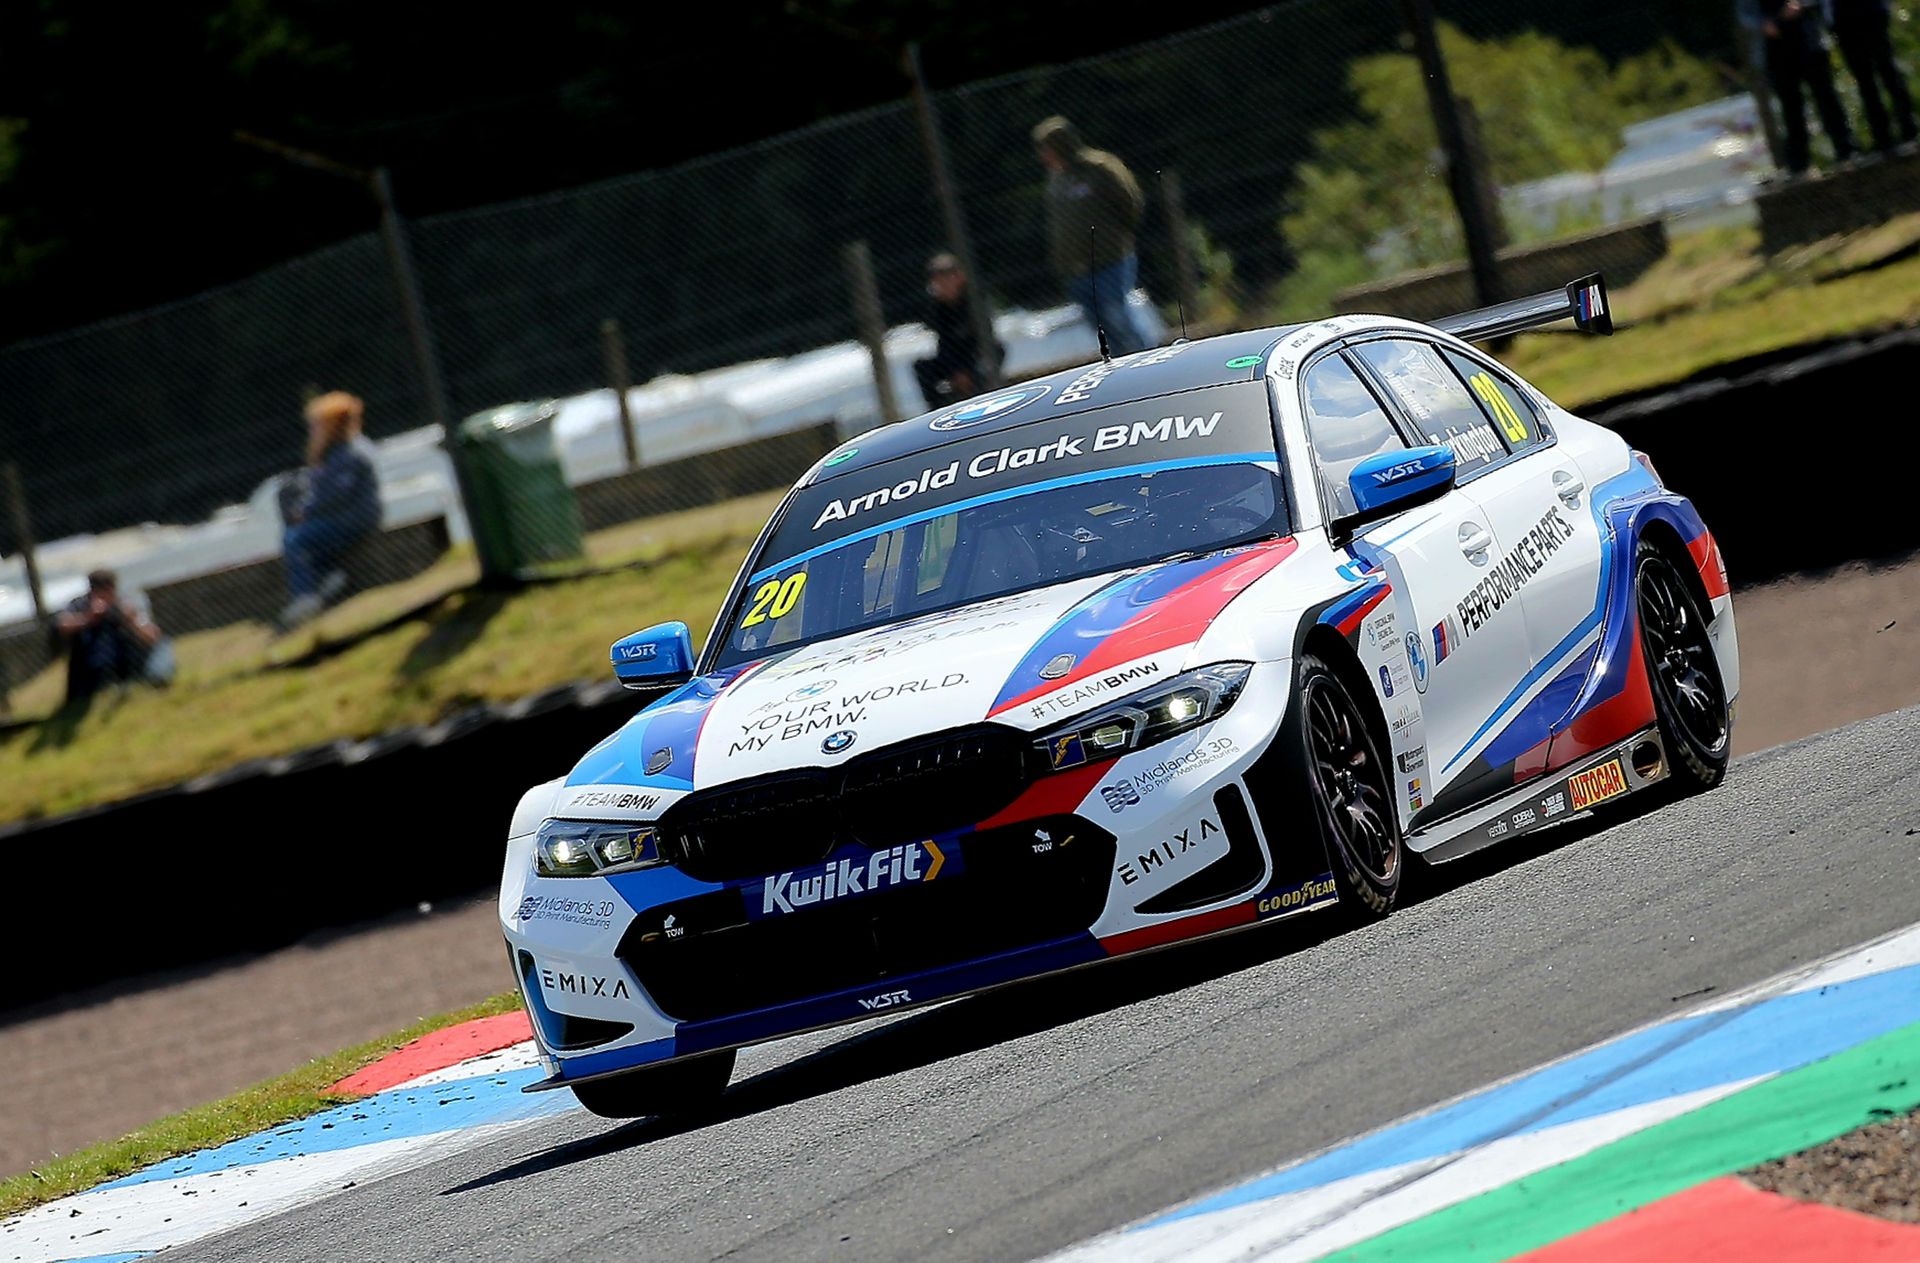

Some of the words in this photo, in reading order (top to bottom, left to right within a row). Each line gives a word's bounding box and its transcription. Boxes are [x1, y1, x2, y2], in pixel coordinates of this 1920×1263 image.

[1470, 371, 1528, 444] 20
[812, 460, 961, 531] Arnold
[968, 434, 1084, 480] Clark
[1093, 411, 1224, 452] BMW
[1371, 460, 1425, 483] WSR
[1456, 536, 1544, 638] PERFORMANCE
[1529, 505, 1575, 562] PARTS.
[740, 571, 808, 630] 20
[620, 643, 657, 659] WSR
[741, 701, 831, 735] YOUR
[842, 673, 970, 707] WORLD.
[1030, 661, 1160, 719] #TEAMBMW
[781, 707, 867, 741] BMW.
[1133, 747, 1207, 787] Midlands
[1208, 737, 1233, 753] 3D
[1140, 785, 1155, 795] 3D
[1155, 773, 1176, 788] Print
[1176, 746, 1239, 777] Manufacturing
[570, 792, 661, 811] #TEAMBMW
[1569, 762, 1623, 808] AUTOCAR
[1512, 808, 1537, 824] COBRA
[1032, 842, 1052, 853] TOW
[539, 896, 594, 915] Midlands
[596, 901, 615, 917] 3D
[1258, 879, 1337, 912] GOODYEAR
[534, 911, 545, 920] 3D
[545, 911, 560, 920] Print
[561, 913, 611, 930] Manufacturing
[665, 927, 684, 938] TOW
[858, 989, 912, 1010] WSR
